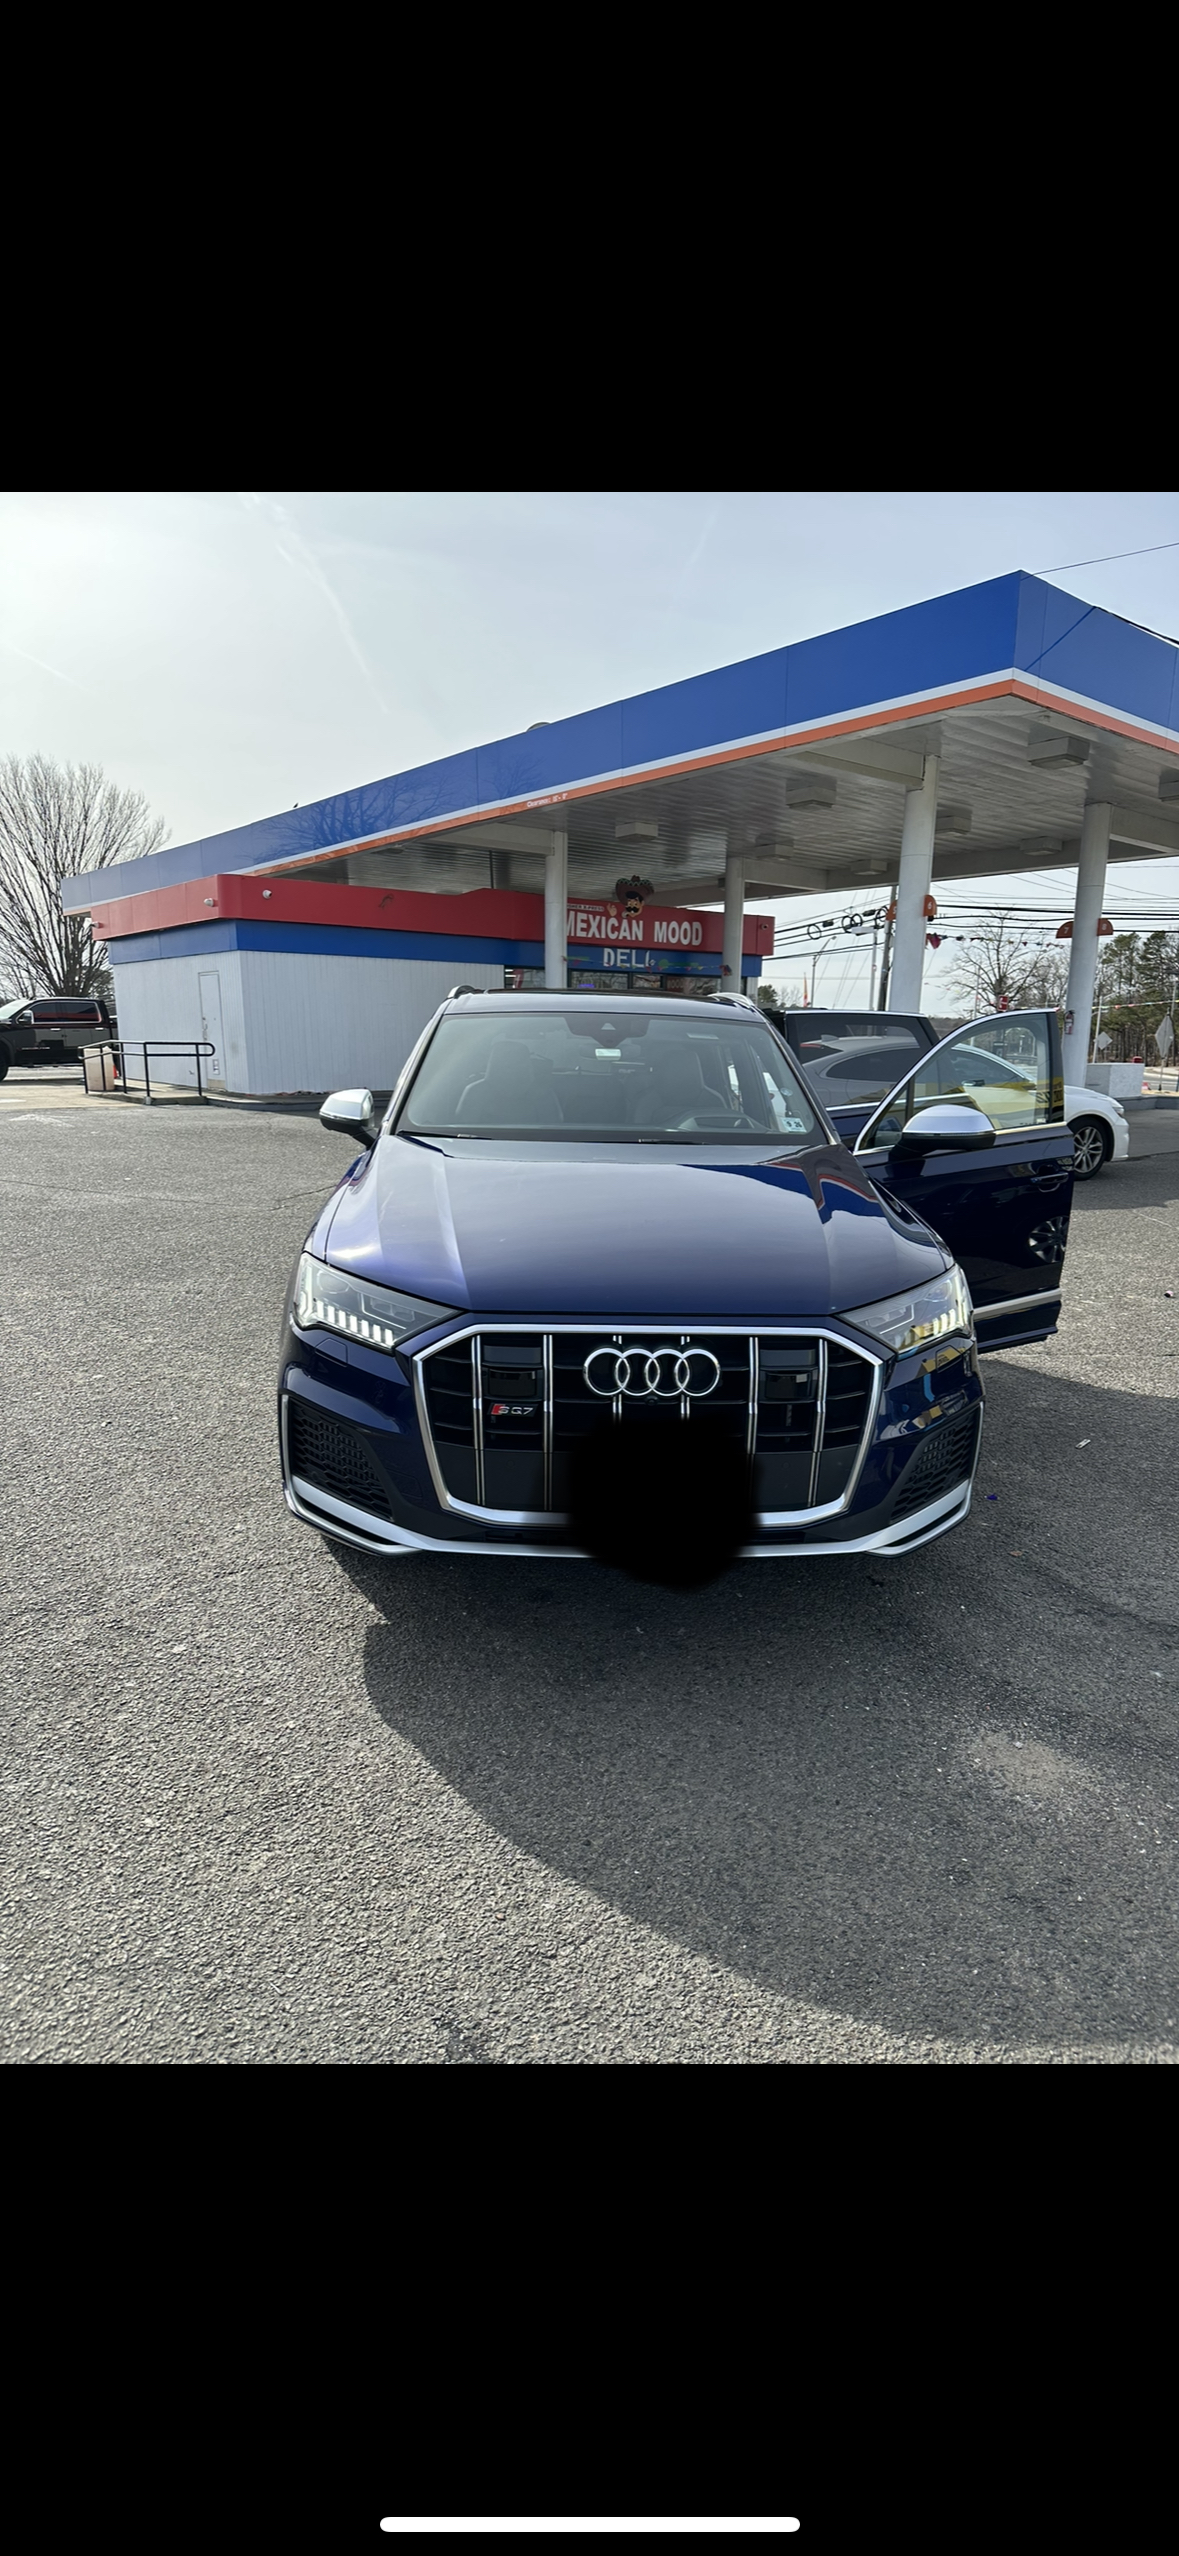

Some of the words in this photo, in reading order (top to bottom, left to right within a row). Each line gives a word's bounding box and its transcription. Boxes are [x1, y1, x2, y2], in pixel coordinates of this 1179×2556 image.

[567, 910, 643, 941] MEXICAN
[654, 920, 703, 946] MOOD
[603, 947, 650, 969] DELI
[497, 1406, 534, 1415] SQ7
